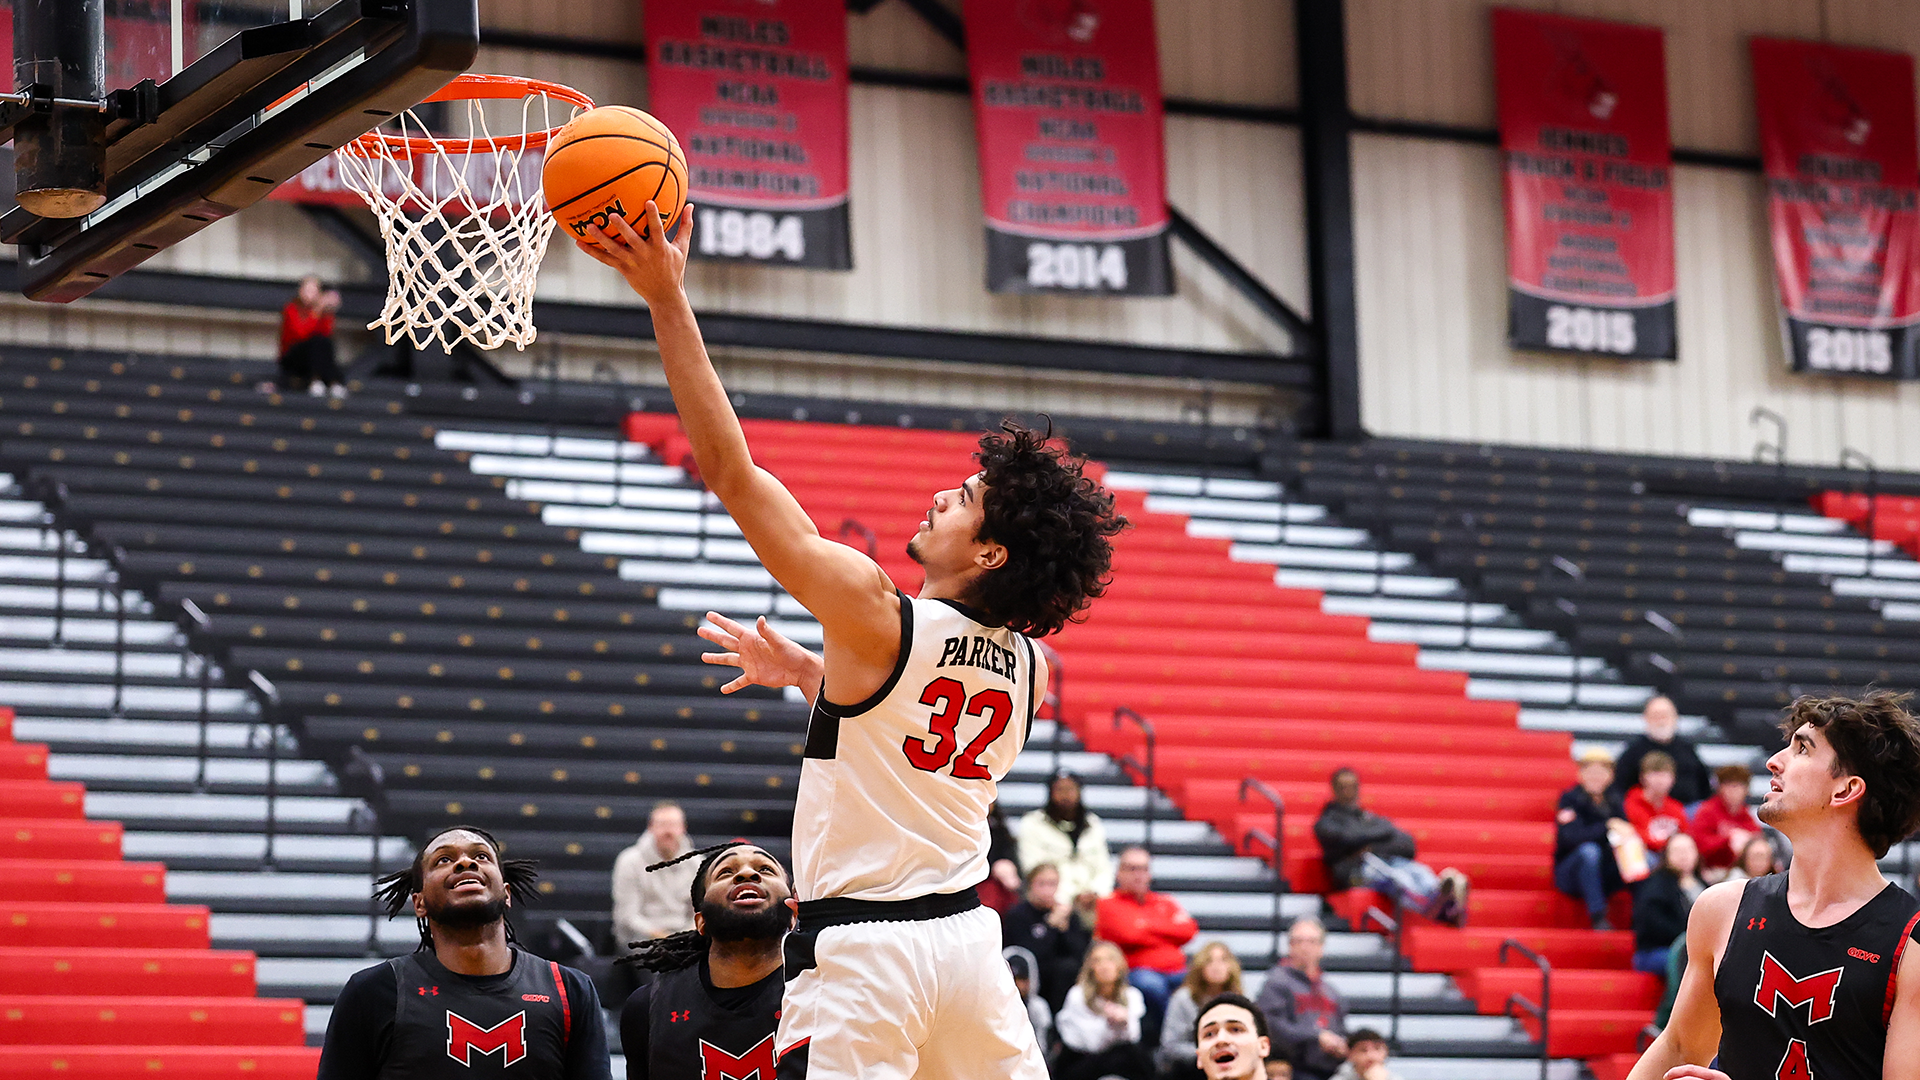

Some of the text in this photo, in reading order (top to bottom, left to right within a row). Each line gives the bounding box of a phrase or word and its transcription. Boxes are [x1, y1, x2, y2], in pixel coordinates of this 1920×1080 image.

[702, 15, 790, 45] MULES
[659, 40, 832, 80] BASKETBALL
[1022, 55, 1105, 80] MULES
[984, 80, 1146, 114] BASKETBALL
[690, 133, 809, 165] NATIONAL
[1015, 170, 1129, 196] NATIONAL
[701, 208, 806, 261] 1984
[1008, 200, 1140, 227] CHAMPIONS
[1027, 242, 1128, 290] 2014
[1546, 306, 1638, 355] 2015
[1806, 327, 1892, 375] 2015
[936, 636, 1017, 685] PARKER
[902, 675, 1013, 781] 32
[1753, 949, 1845, 1026] M
[446, 1009, 527, 1069] M
[699, 1030, 779, 1080] M
